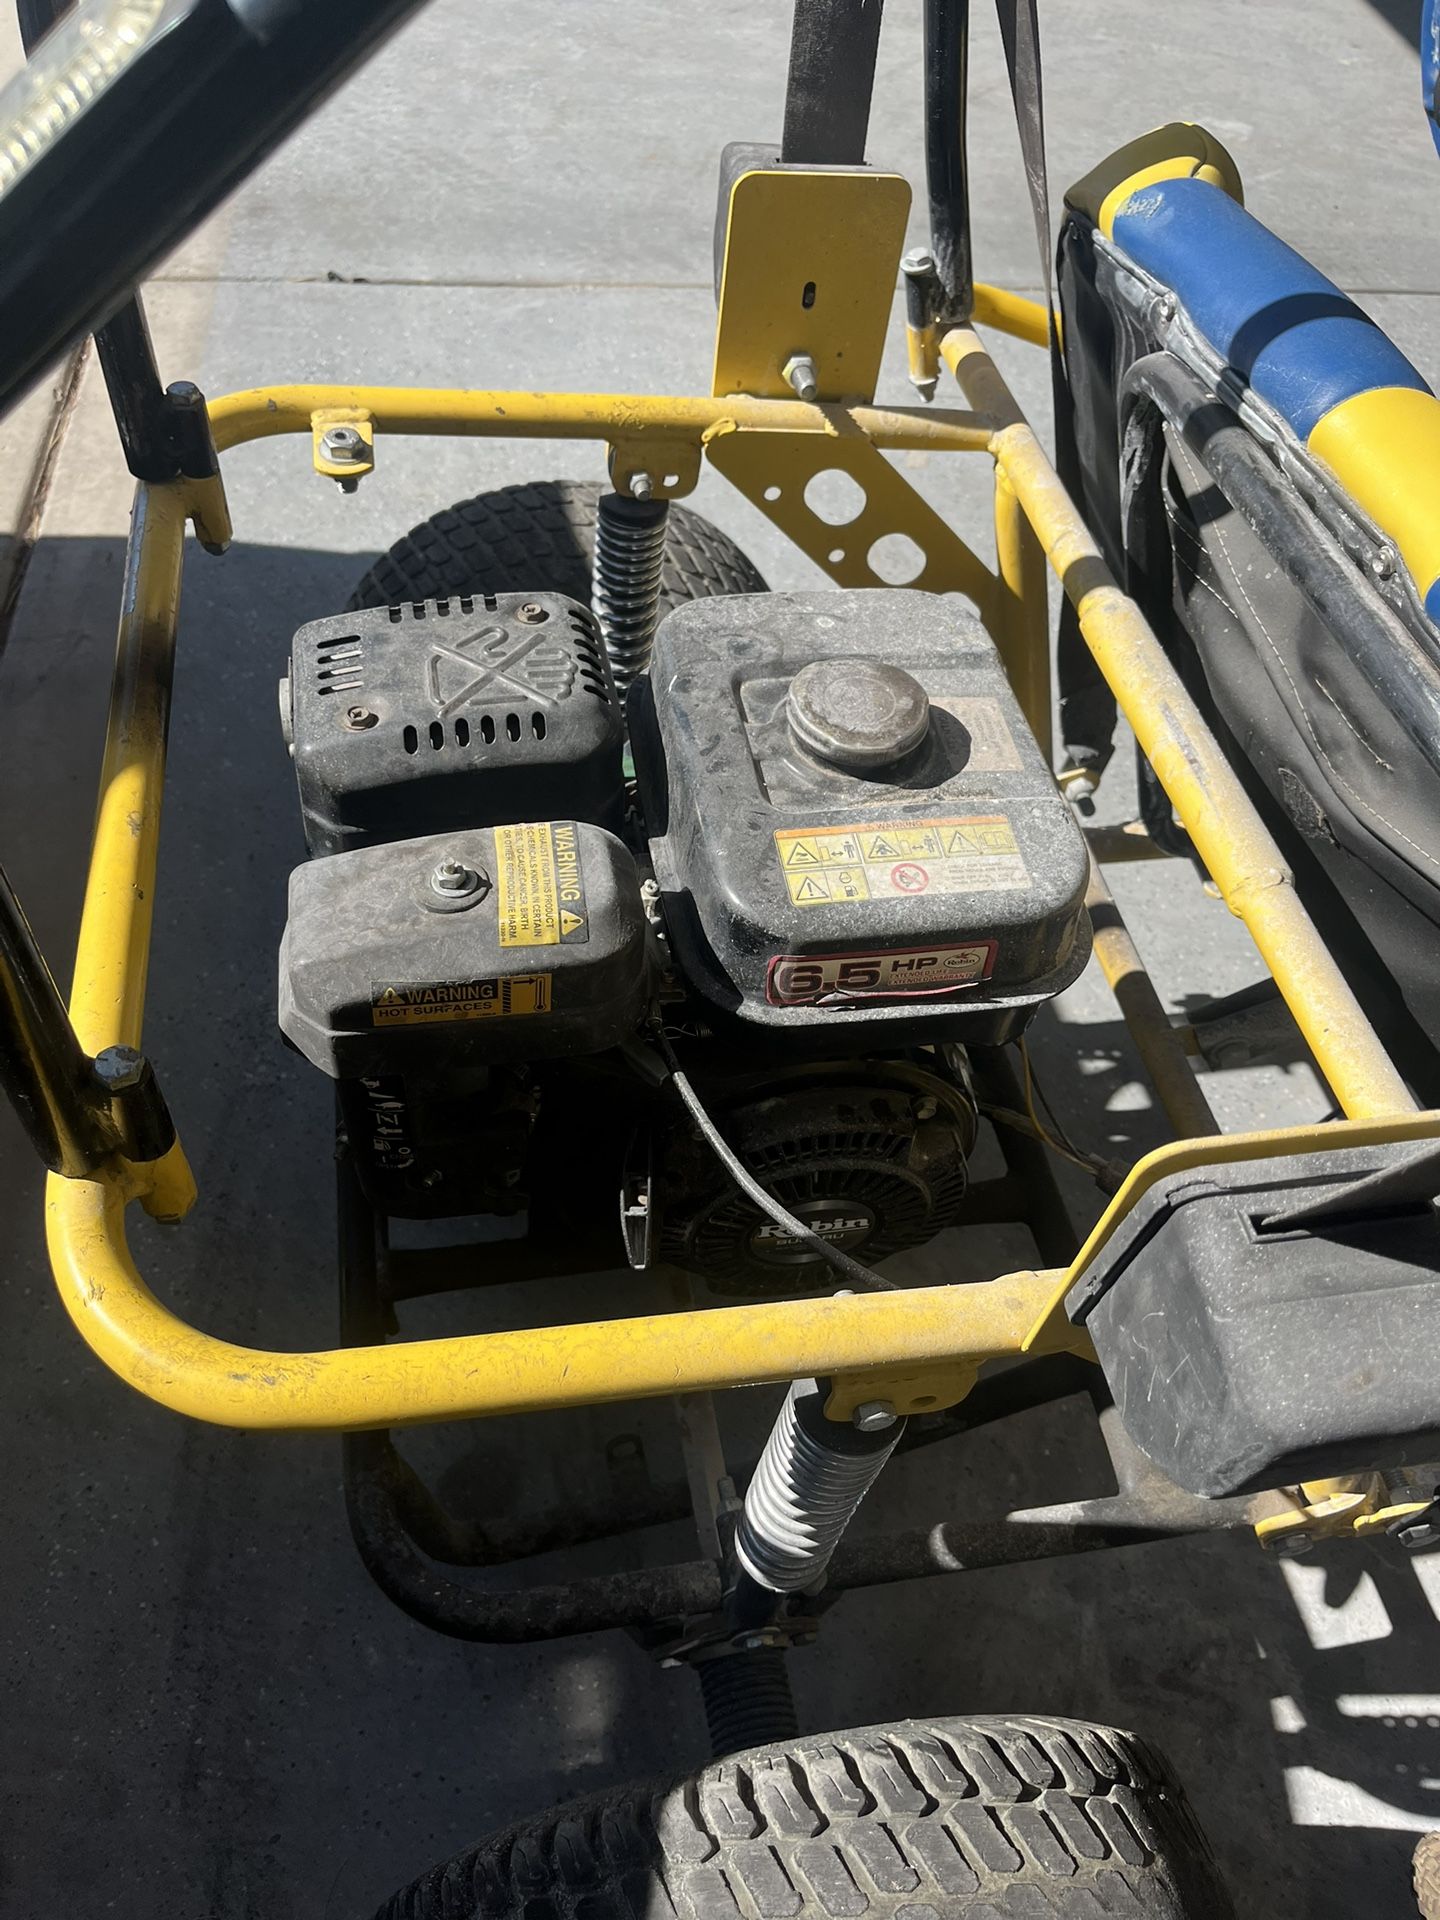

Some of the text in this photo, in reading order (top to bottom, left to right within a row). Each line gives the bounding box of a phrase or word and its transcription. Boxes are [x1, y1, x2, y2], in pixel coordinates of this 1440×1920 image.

[503, 829, 511, 839] OR
[539, 828, 549, 858] EXHAUST
[504, 840, 513, 862] OTHER
[516, 844, 524, 854] TO
[527, 830, 538, 869] CHEMICALS
[517, 854, 527, 877] CAUSE
[554, 826, 581, 902] WARNING
[505, 862, 516, 914] REPRODUCTIVE
[543, 879, 552, 894] THIS
[520, 907, 529, 930] BIRTH
[532, 904, 542, 938] CERTAIN
[544, 894, 555, 929] PRODUCT
[946, 957, 976, 966] Robin
[778, 957, 938, 995] 6.5 HP
[889, 969, 930, 979] EXTENDED
[407, 985, 493, 1003] WARNING
[378, 1007, 410, 1018] HOT
[413, 1001, 493, 1016] SURFACES
[757, 1217, 870, 1238] Rbin
[776, 1233, 845, 1246] SURU
